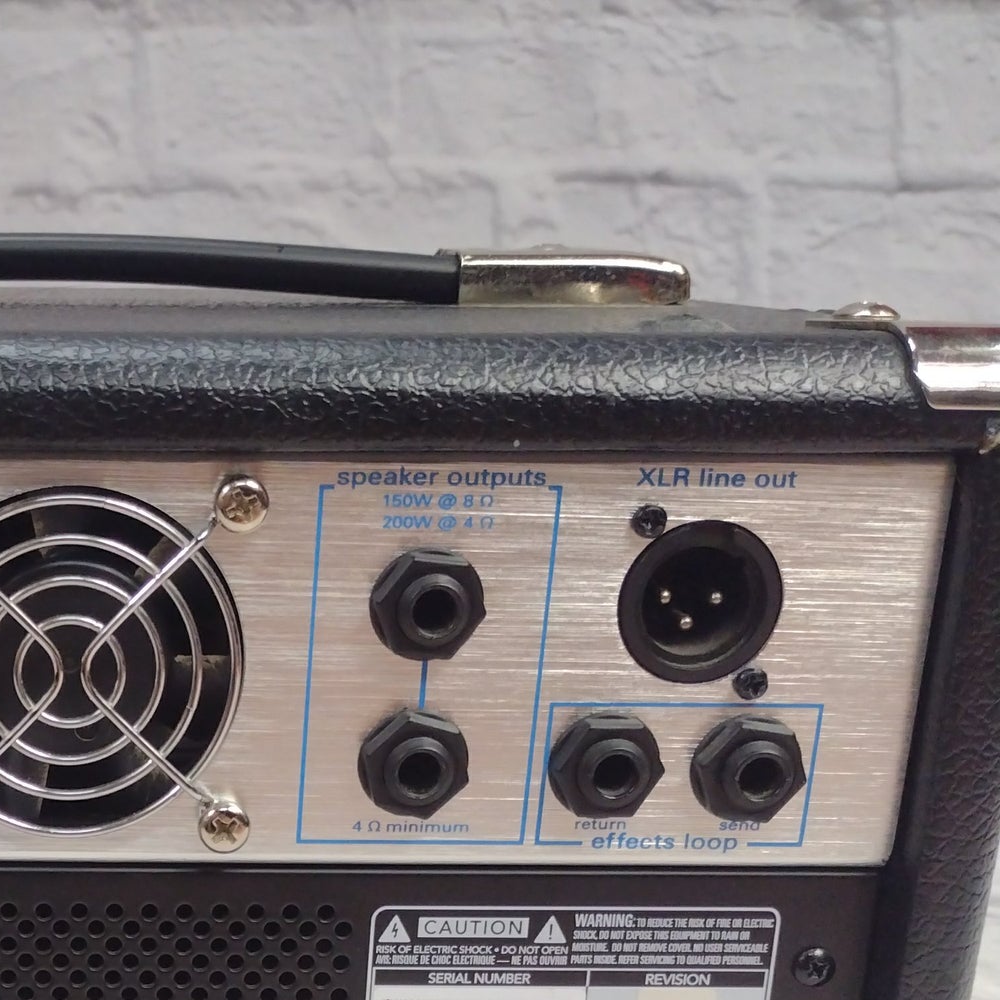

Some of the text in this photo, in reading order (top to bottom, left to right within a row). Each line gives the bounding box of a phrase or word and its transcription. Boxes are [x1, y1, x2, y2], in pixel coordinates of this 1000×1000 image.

[337, 466, 546, 489] speaker outputs
[636, 467, 798, 488] XLR line out
[383, 494, 433, 508] 150W
[438, 493, 456, 510] @
[463, 495, 474, 508] 8
[383, 516, 432, 529] 200W
[438, 516, 456, 531] @
[464, 517, 473, 529] 4
[352, 821, 362, 832] 4
[386, 821, 469, 832] minimum
[574, 820, 626, 830] return
[719, 820, 760, 831] send
[592, 832, 738, 853] effects loop
[575, 914, 636, 927] WARNING:
[424, 920, 522, 935] CAUTION
[376, 945, 568, 955] RISK OF ELECTRIC SHOCK DO NOT OPEN
[428, 973, 531, 984] SERIAL NUMBER
[645, 973, 711, 986] REVISION
